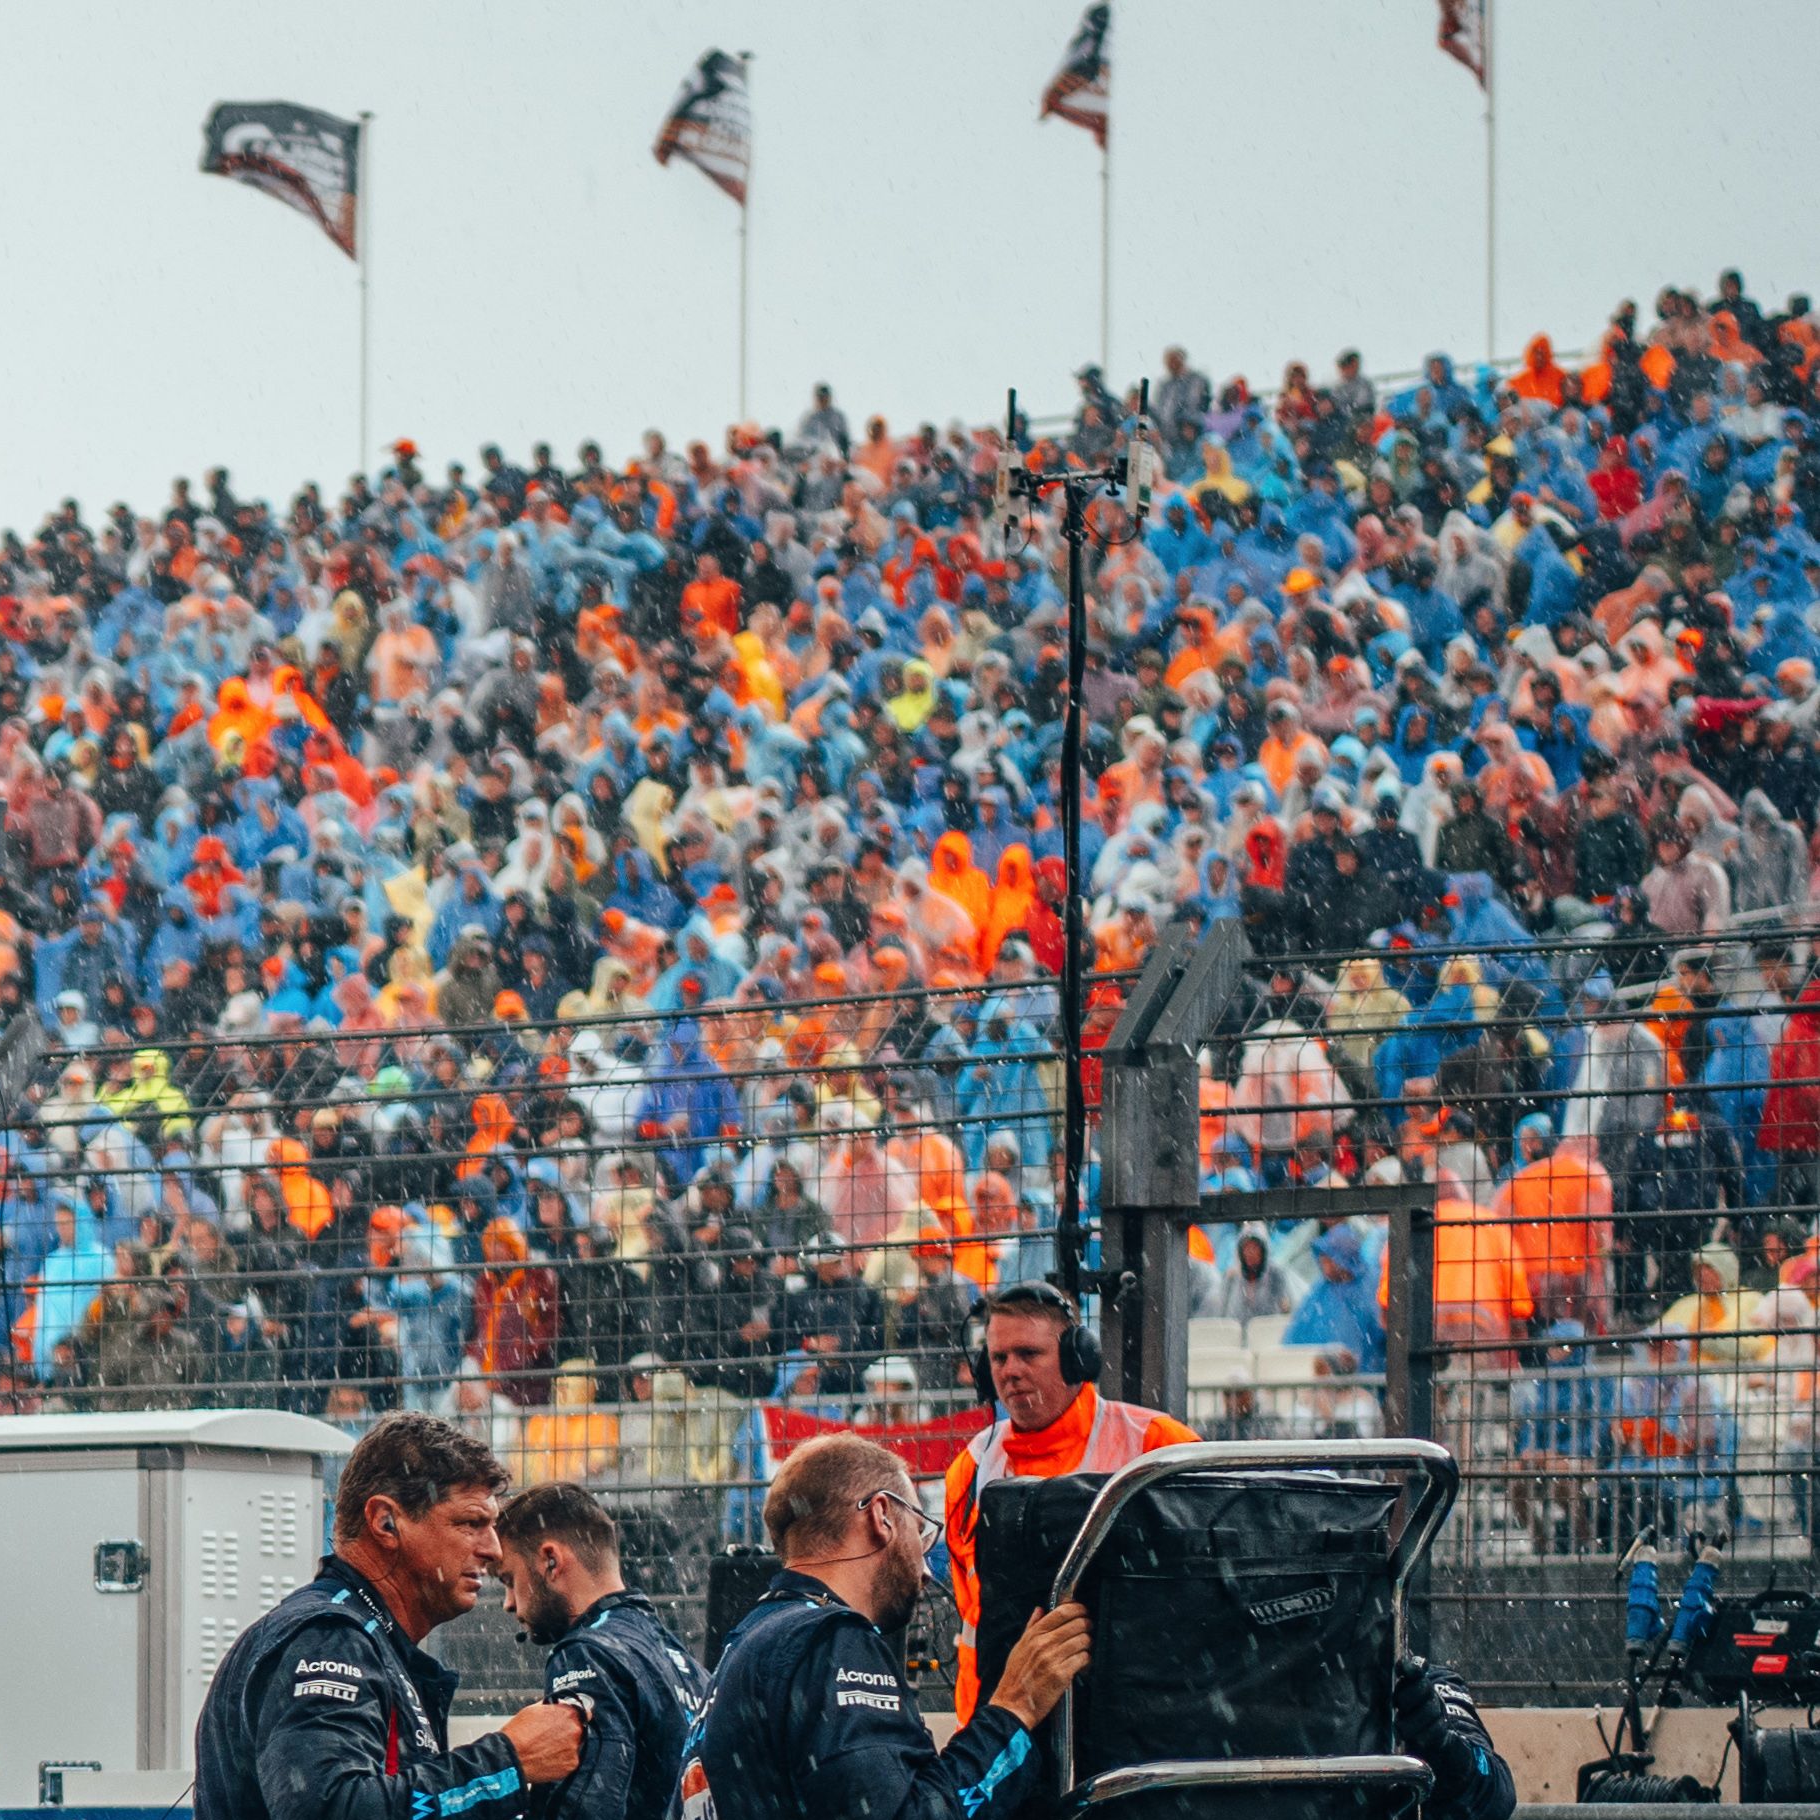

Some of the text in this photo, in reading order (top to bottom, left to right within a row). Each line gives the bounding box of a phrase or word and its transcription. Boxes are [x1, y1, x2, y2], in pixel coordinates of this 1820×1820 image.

[295, 1659, 363, 1678] Acronis
[836, 1667, 898, 1688] Acronis
[294, 1679, 359, 1703] PIRELLI
[836, 1690, 900, 1712] PIRELLI
